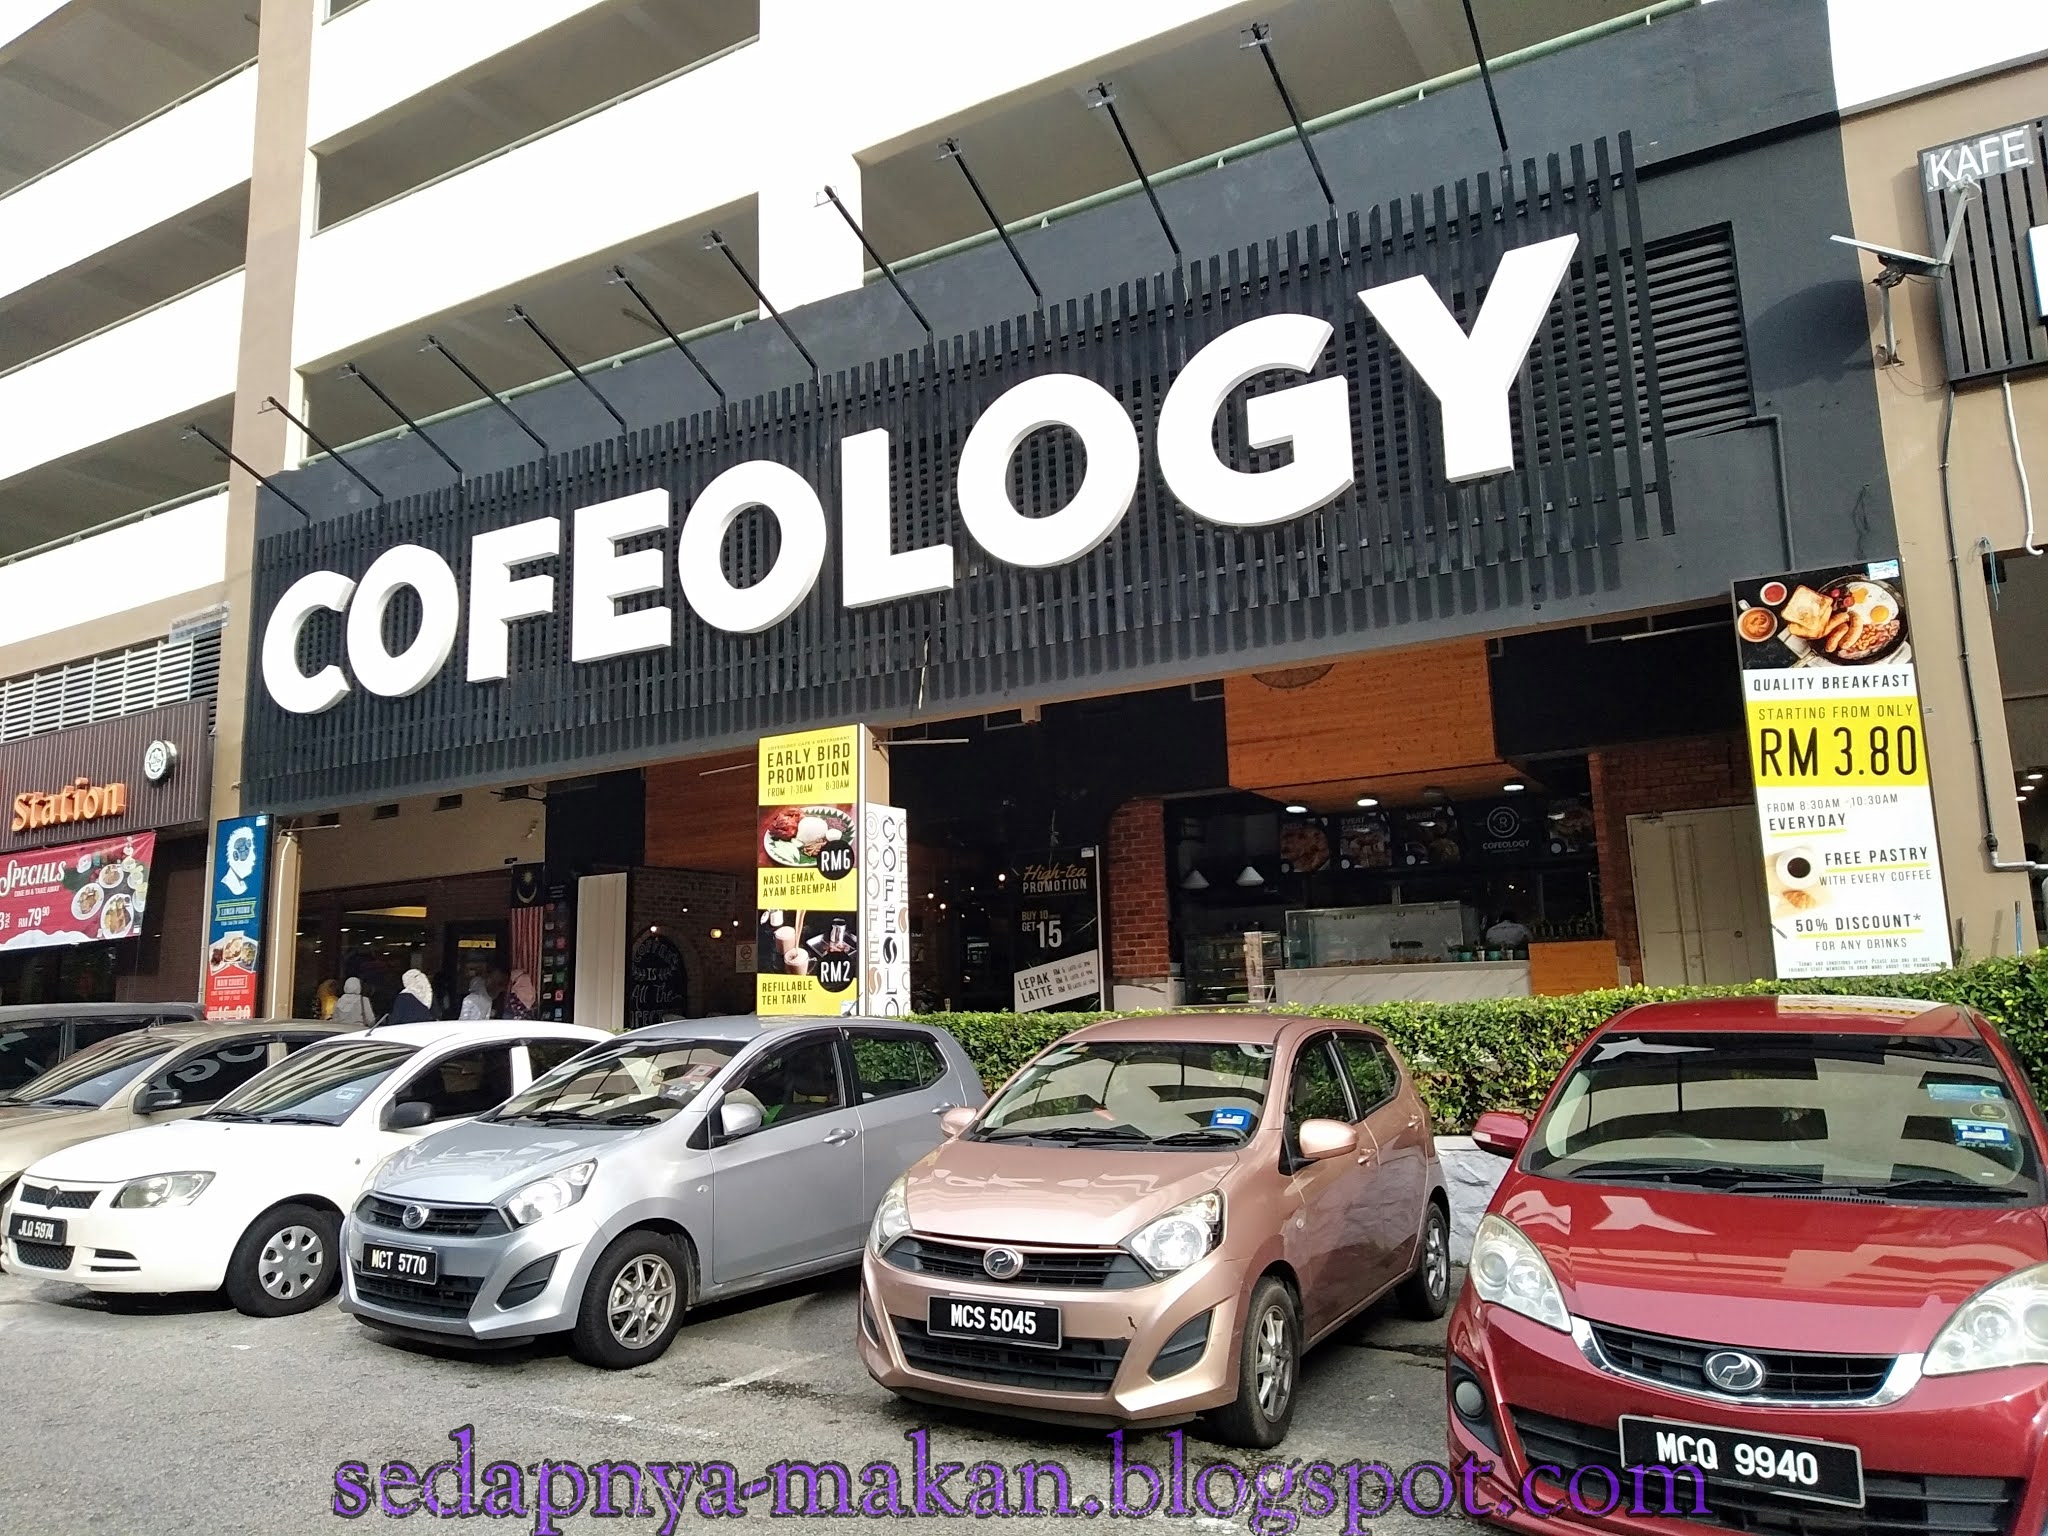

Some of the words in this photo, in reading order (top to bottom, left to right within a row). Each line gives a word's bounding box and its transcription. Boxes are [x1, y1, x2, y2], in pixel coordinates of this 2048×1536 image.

[1930, 130, 2029, 187] KAFE
[260, 232, 1581, 715] COFEOLOGY
[1753, 677, 1815, 691] QUALITY
[1822, 674, 1910, 690] BREAKFAST
[1758, 706, 1826, 721] STARTING
[1833, 705, 1870, 718] FROM
[1877, 703, 1914, 717] ONLY
[767, 747, 811, 768] EARLY
[817, 742, 850, 762] BIRD
[1760, 726, 1818, 777] RM
[1833, 725, 1917, 776] 3.80
[767, 760, 850, 785] PROMOTION
[767, 787, 785, 798] FROM
[1767, 801, 1795, 813] FROM
[1799, 798, 1840, 811] 8:30AM
[1769, 813, 1846, 831] EVERYDAY
[821, 849, 850, 872] RM6
[1825, 851, 1861, 866] FREE
[1869, 847, 1928, 863] PASTRY
[763, 873, 783, 885] NASI
[786, 872, 815, 885] LEMAK
[1022, 878, 1087, 894] PROMOTION
[1819, 874, 1846, 886] WITH
[1851, 872, 1886, 885] EVERY
[1891, 869, 1932, 882] COFFEE
[763, 886, 786, 897] AYAM
[790, 882, 837, 895] BEREMPAH
[1021, 911, 1037, 921] BUY
[1796, 919, 1828, 932] 50%
[1021, 921, 1036, 932] GET
[1036, 920, 1063, 949] 15
[1815, 941, 1835, 951] FOR
[1841, 939, 1861, 950] ANY
[1867, 937, 1907, 949] DRINKS
[820, 960, 850, 983] RM2
[762, 980, 813, 992] REFILLABLE
[1017, 972, 1050, 991] LEPAK
[762, 995, 778, 1005] TEH
[781, 993, 807, 1005] TARIK
[1021, 984, 1054, 1004] LATTE
[34, 1221, 55, 1240] 5974
[371, 1249, 394, 1270] MCT
[398, 1253, 427, 1275] 5770
[950, 1303, 985, 1330] MCS
[990, 1307, 1037, 1335] 5045
[1655, 1431, 1719, 1470] MCQ
[1734, 1443, 1819, 1485] 9940
